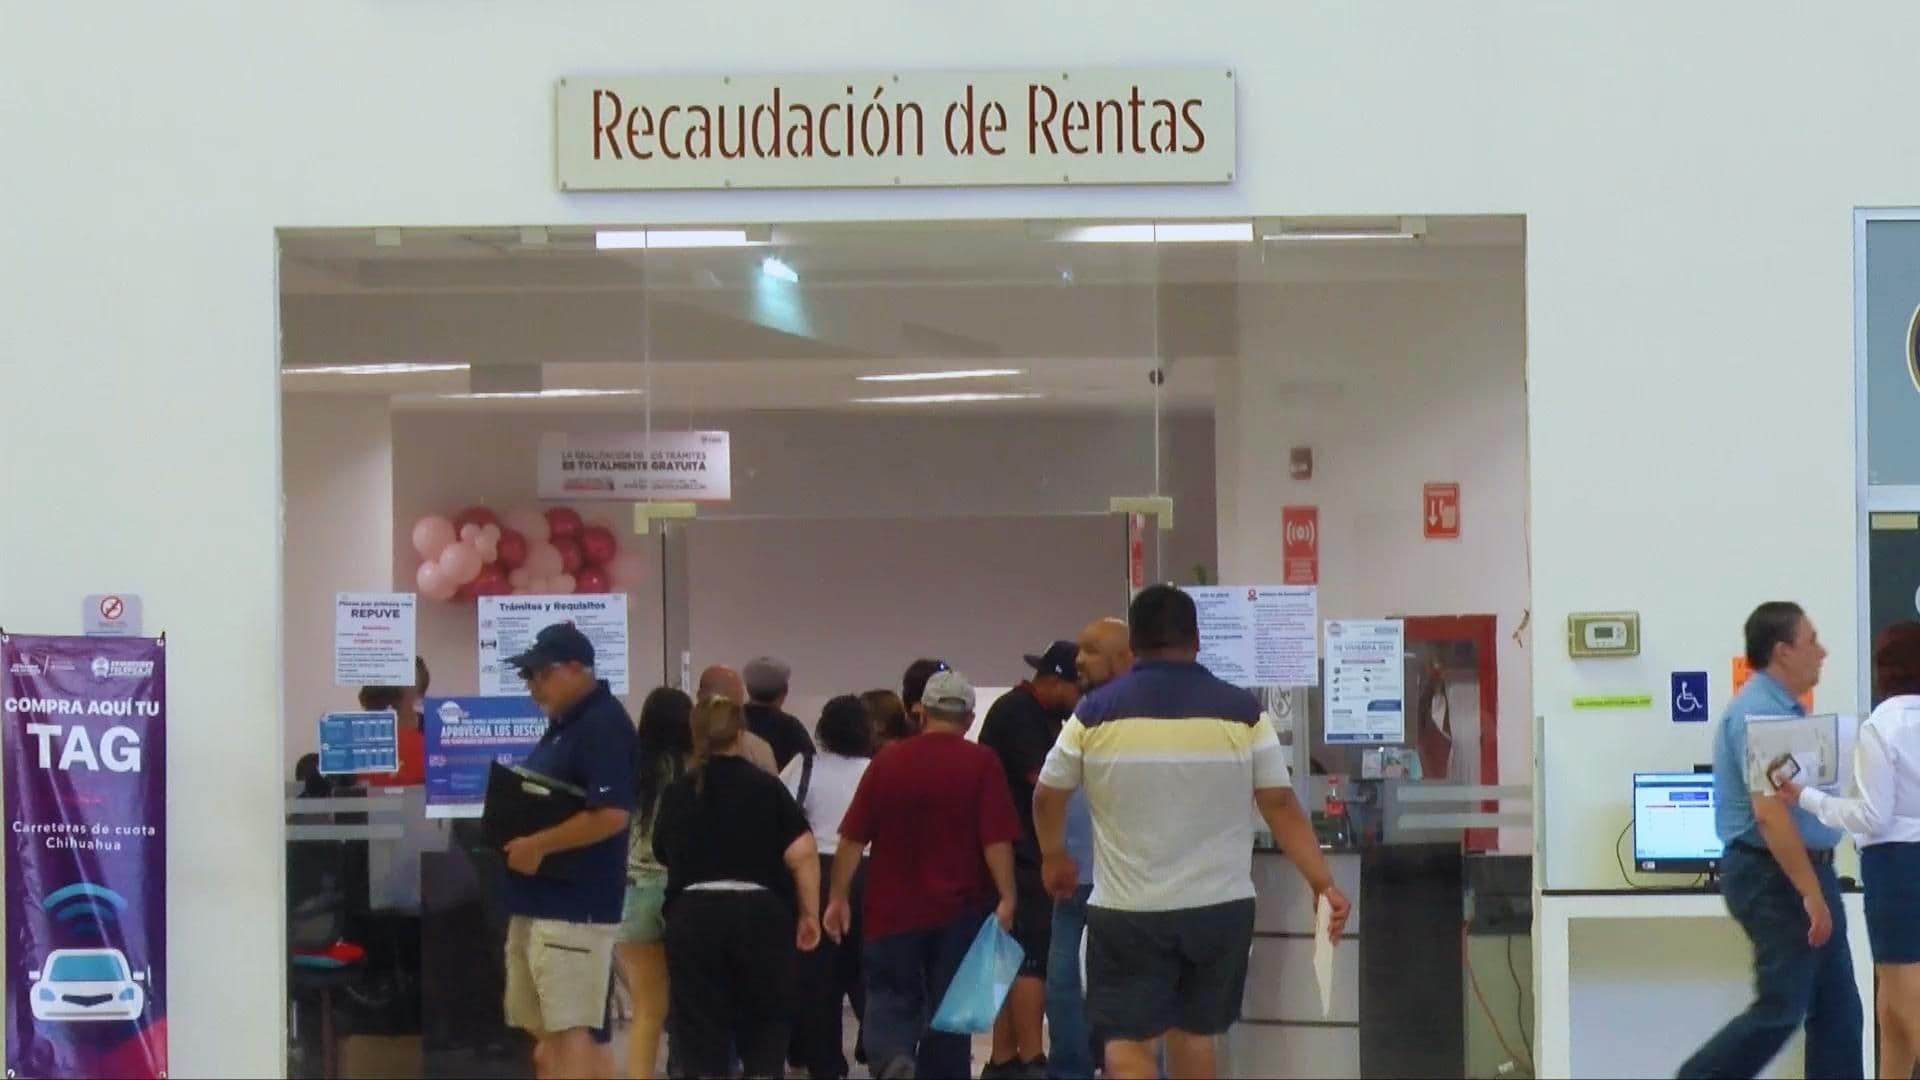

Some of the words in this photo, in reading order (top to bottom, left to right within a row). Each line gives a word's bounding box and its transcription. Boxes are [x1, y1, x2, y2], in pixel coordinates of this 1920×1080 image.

[592, 86, 924, 160] Recaudación
[944, 84, 1008, 156] de
[1028, 82, 1206, 155] Rentas
[577, 461, 648, 472] TOTALMENTE
[651, 461, 706, 472] GRATUITA
[351, 608, 400, 619] REPUVE
[499, 602, 543, 612] Trámites
[544, 603, 551, 613] y
[553, 601, 606, 612] Requisitos
[5, 697, 84, 715] COMPRA
[87, 697, 132, 716] AQUÍ
[135, 701, 159, 716] TU
[440, 724, 492, 738] APROVECHA
[493, 724, 511, 738] LOS
[513, 723, 546, 738] DESCU
[27, 723, 141, 772] TAG
[12, 820, 86, 835] Carreteras
[91, 823, 109, 835] de
[114, 824, 156, 837] cuota
[46, 837, 121, 851] Chihuahua
